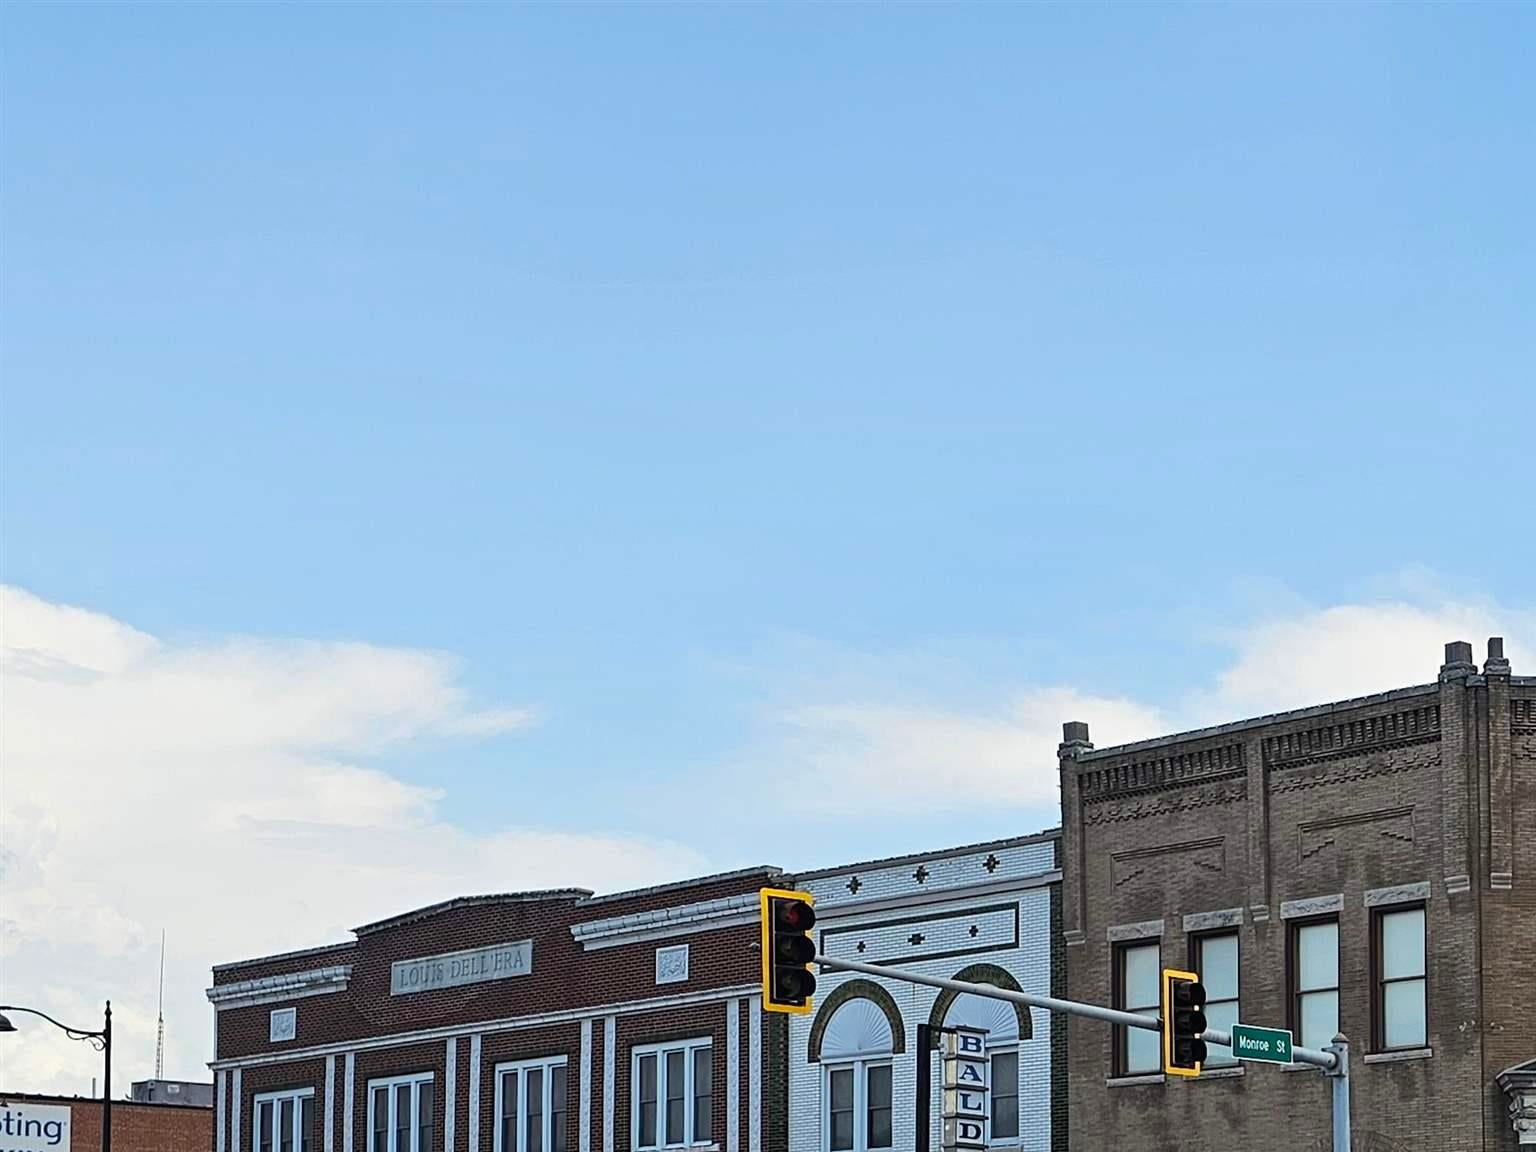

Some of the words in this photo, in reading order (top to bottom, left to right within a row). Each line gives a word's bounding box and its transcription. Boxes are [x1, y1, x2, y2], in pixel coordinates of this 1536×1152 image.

[400, 963, 444, 986] LOUIS
[1239, 1035, 1270, 1052] Monroe
[1276, 1039, 1286, 1054] St
[0, 1111, 62, 1145] ting
